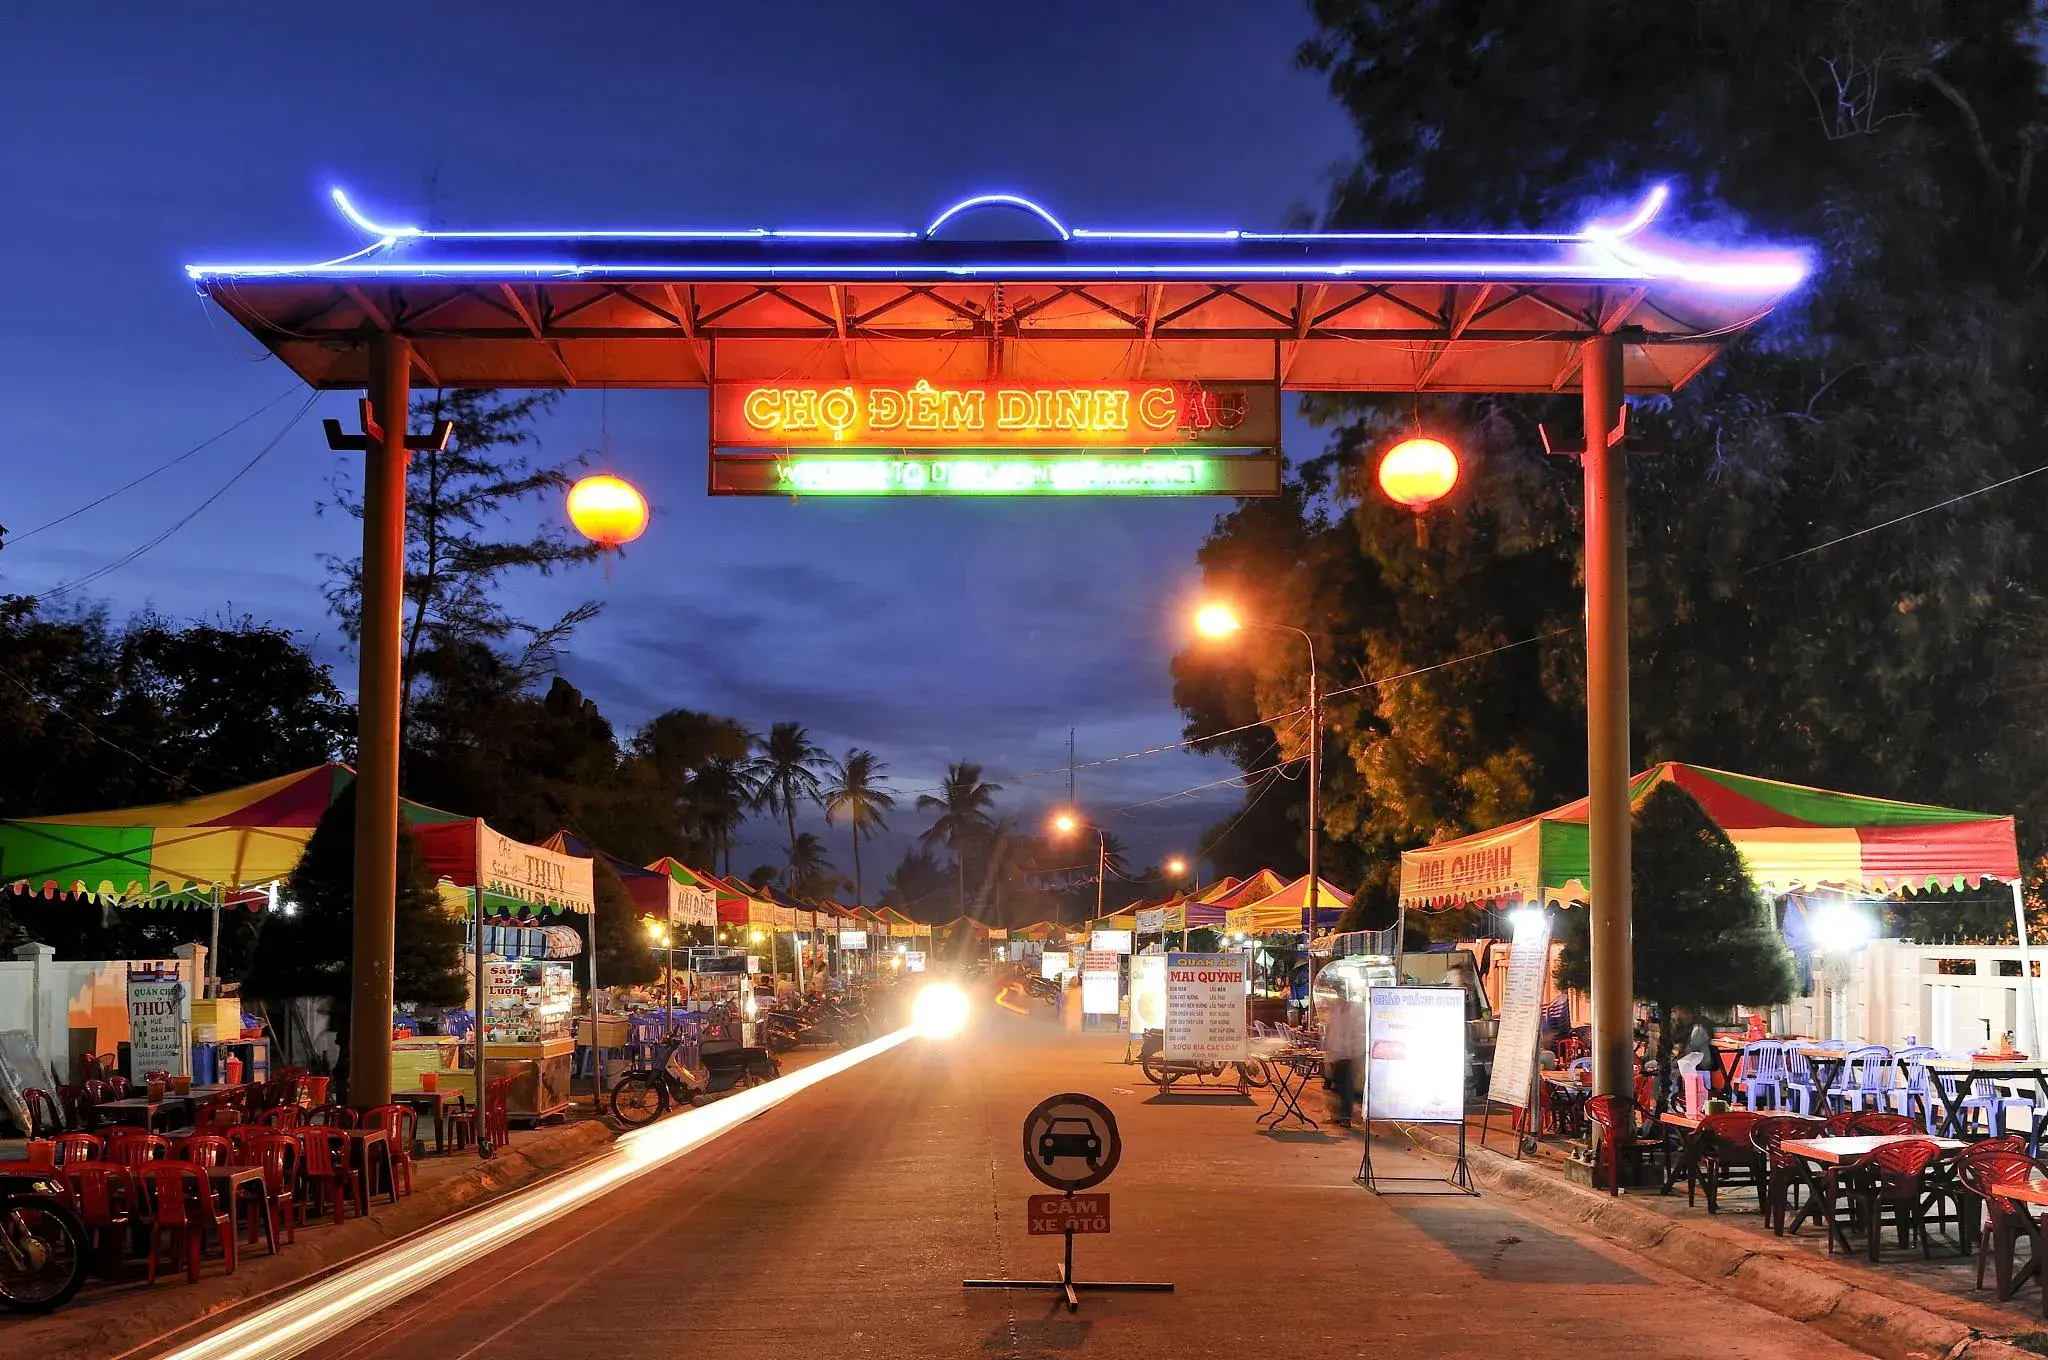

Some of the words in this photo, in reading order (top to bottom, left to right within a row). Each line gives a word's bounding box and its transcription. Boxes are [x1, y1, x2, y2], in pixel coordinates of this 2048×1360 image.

[743, 386, 858, 441] CHỢ
[868, 378, 985, 430] ĐÊM
[997, 389, 1130, 430] DINH
[1418, 860, 1445, 889] MAI
[1170, 971, 1195, 983] MAI
[1198, 969, 1243, 984] QUỲNH
[1032, 1218, 1058, 1232] XE
